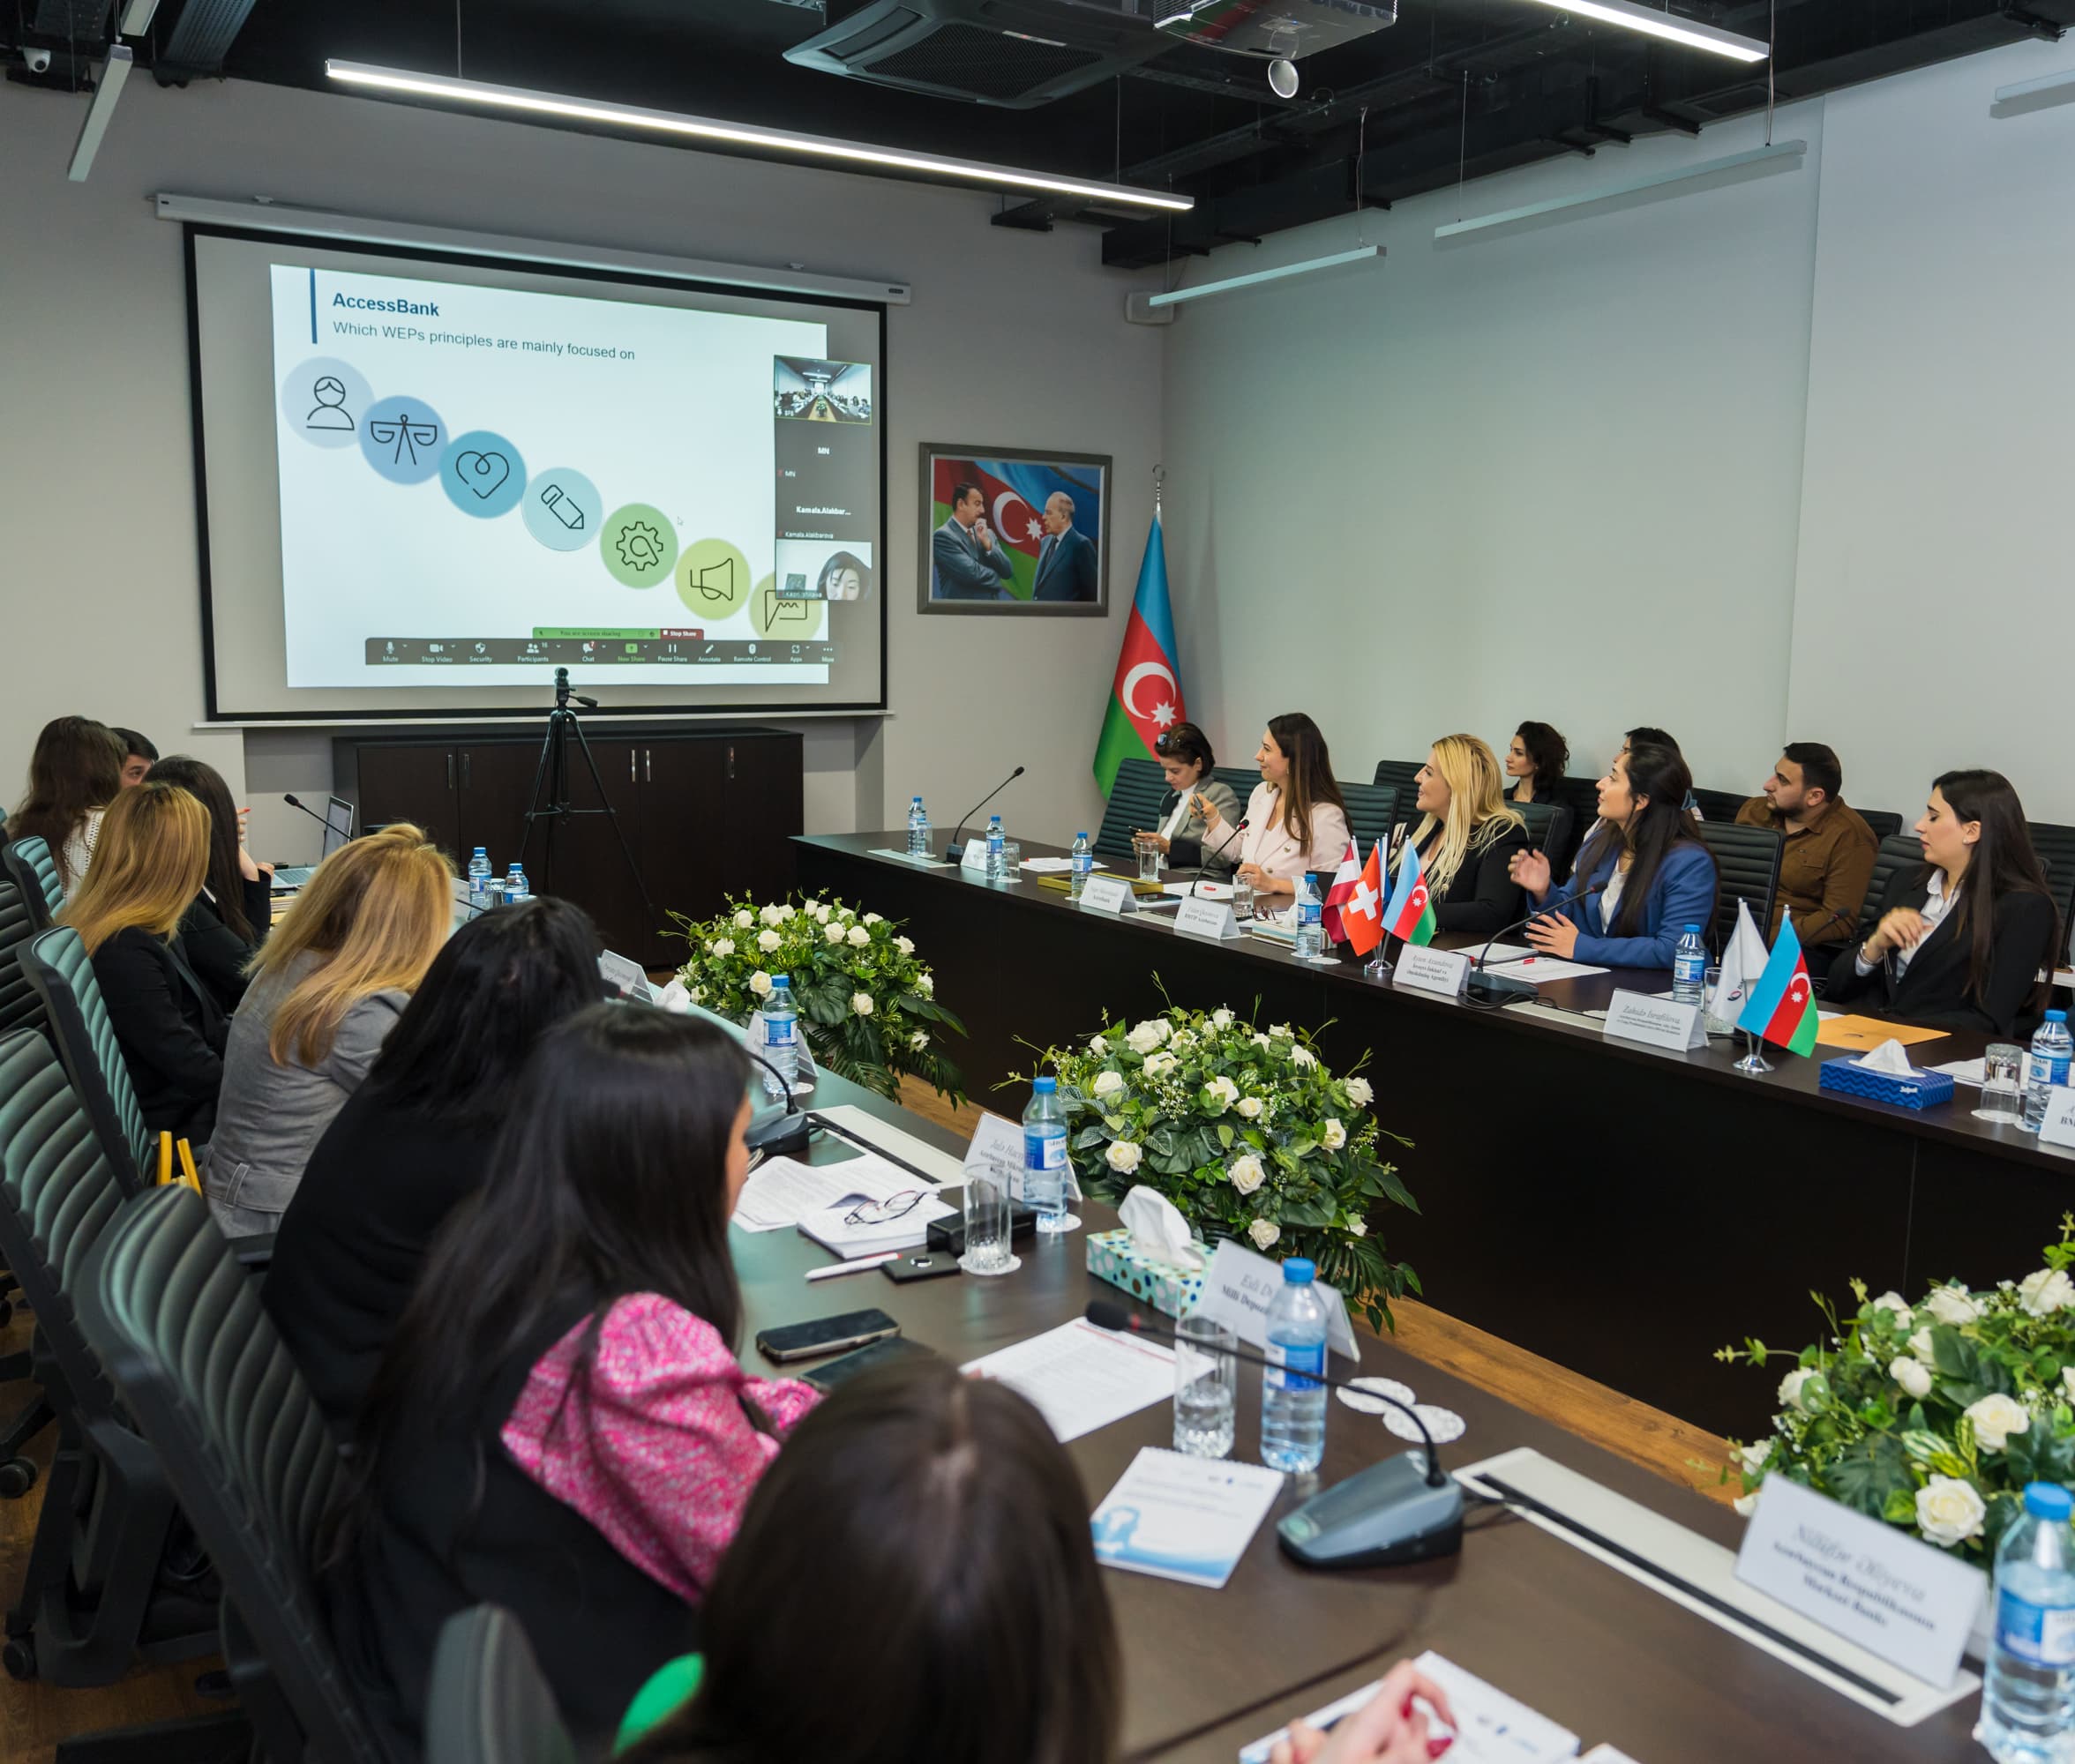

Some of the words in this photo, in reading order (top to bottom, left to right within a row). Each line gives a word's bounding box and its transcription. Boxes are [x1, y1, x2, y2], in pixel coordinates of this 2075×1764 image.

[333, 292, 439, 317] AccessBank
[333, 321, 378, 337] Which
[382, 325, 425, 340] WEPs
[430, 332, 492, 348] principles
[497, 338, 518, 350] are
[522, 340, 563, 356] mainly
[567, 343, 616, 359] focused
[619, 350, 635, 361] on
